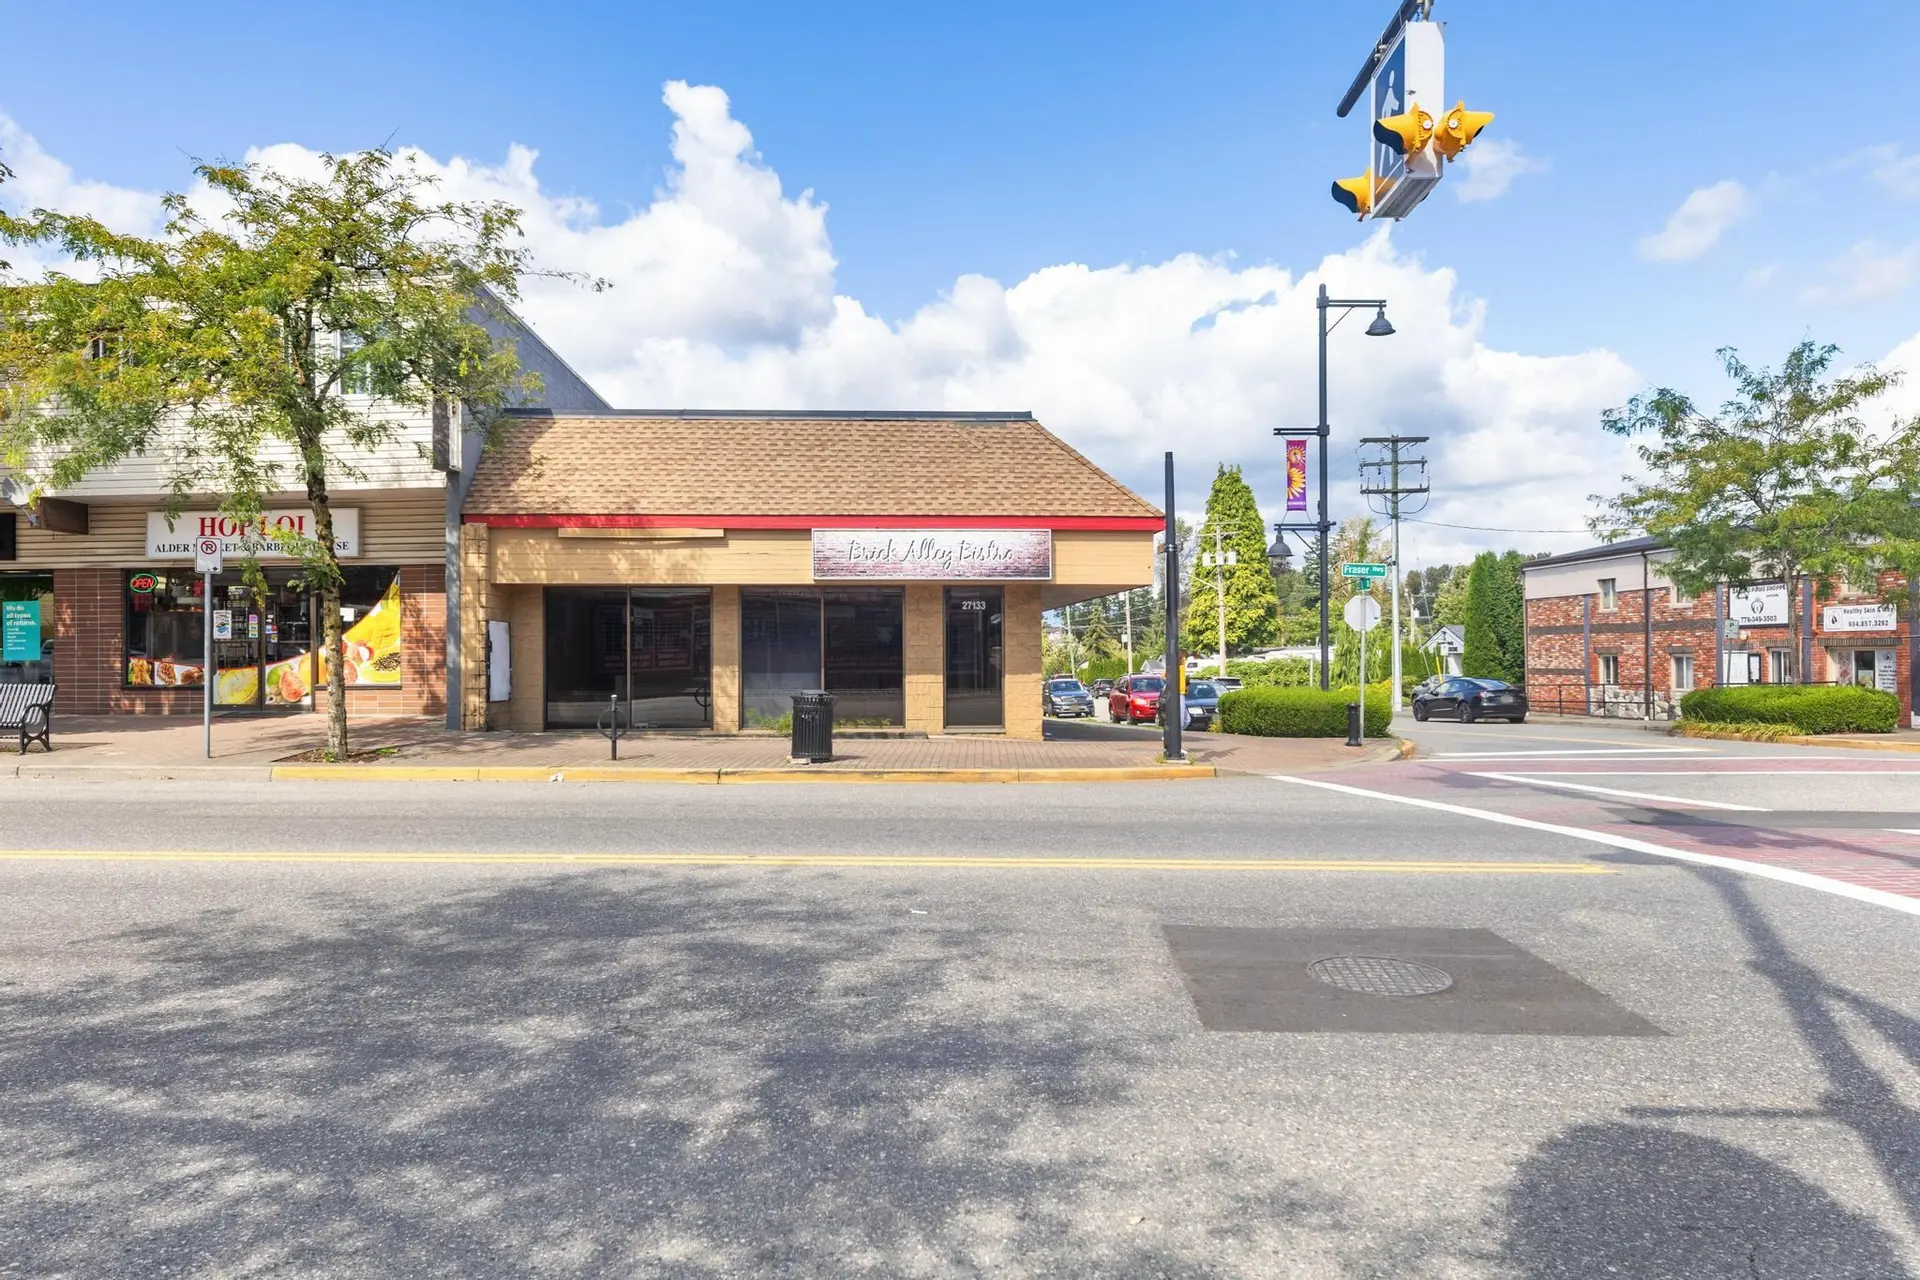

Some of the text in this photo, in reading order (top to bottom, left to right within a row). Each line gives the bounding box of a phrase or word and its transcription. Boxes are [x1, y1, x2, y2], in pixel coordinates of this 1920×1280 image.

[199, 515, 254, 537] HOP
[155, 543, 190, 553] ALDER
[849, 538, 1013, 570] Brick Alley Bistro
[1344, 566, 1369, 574] Fraser
[131, 577, 154, 589] OPEN
[962, 601, 986, 610] 27133
[1864, 606, 1876, 614] Skin
